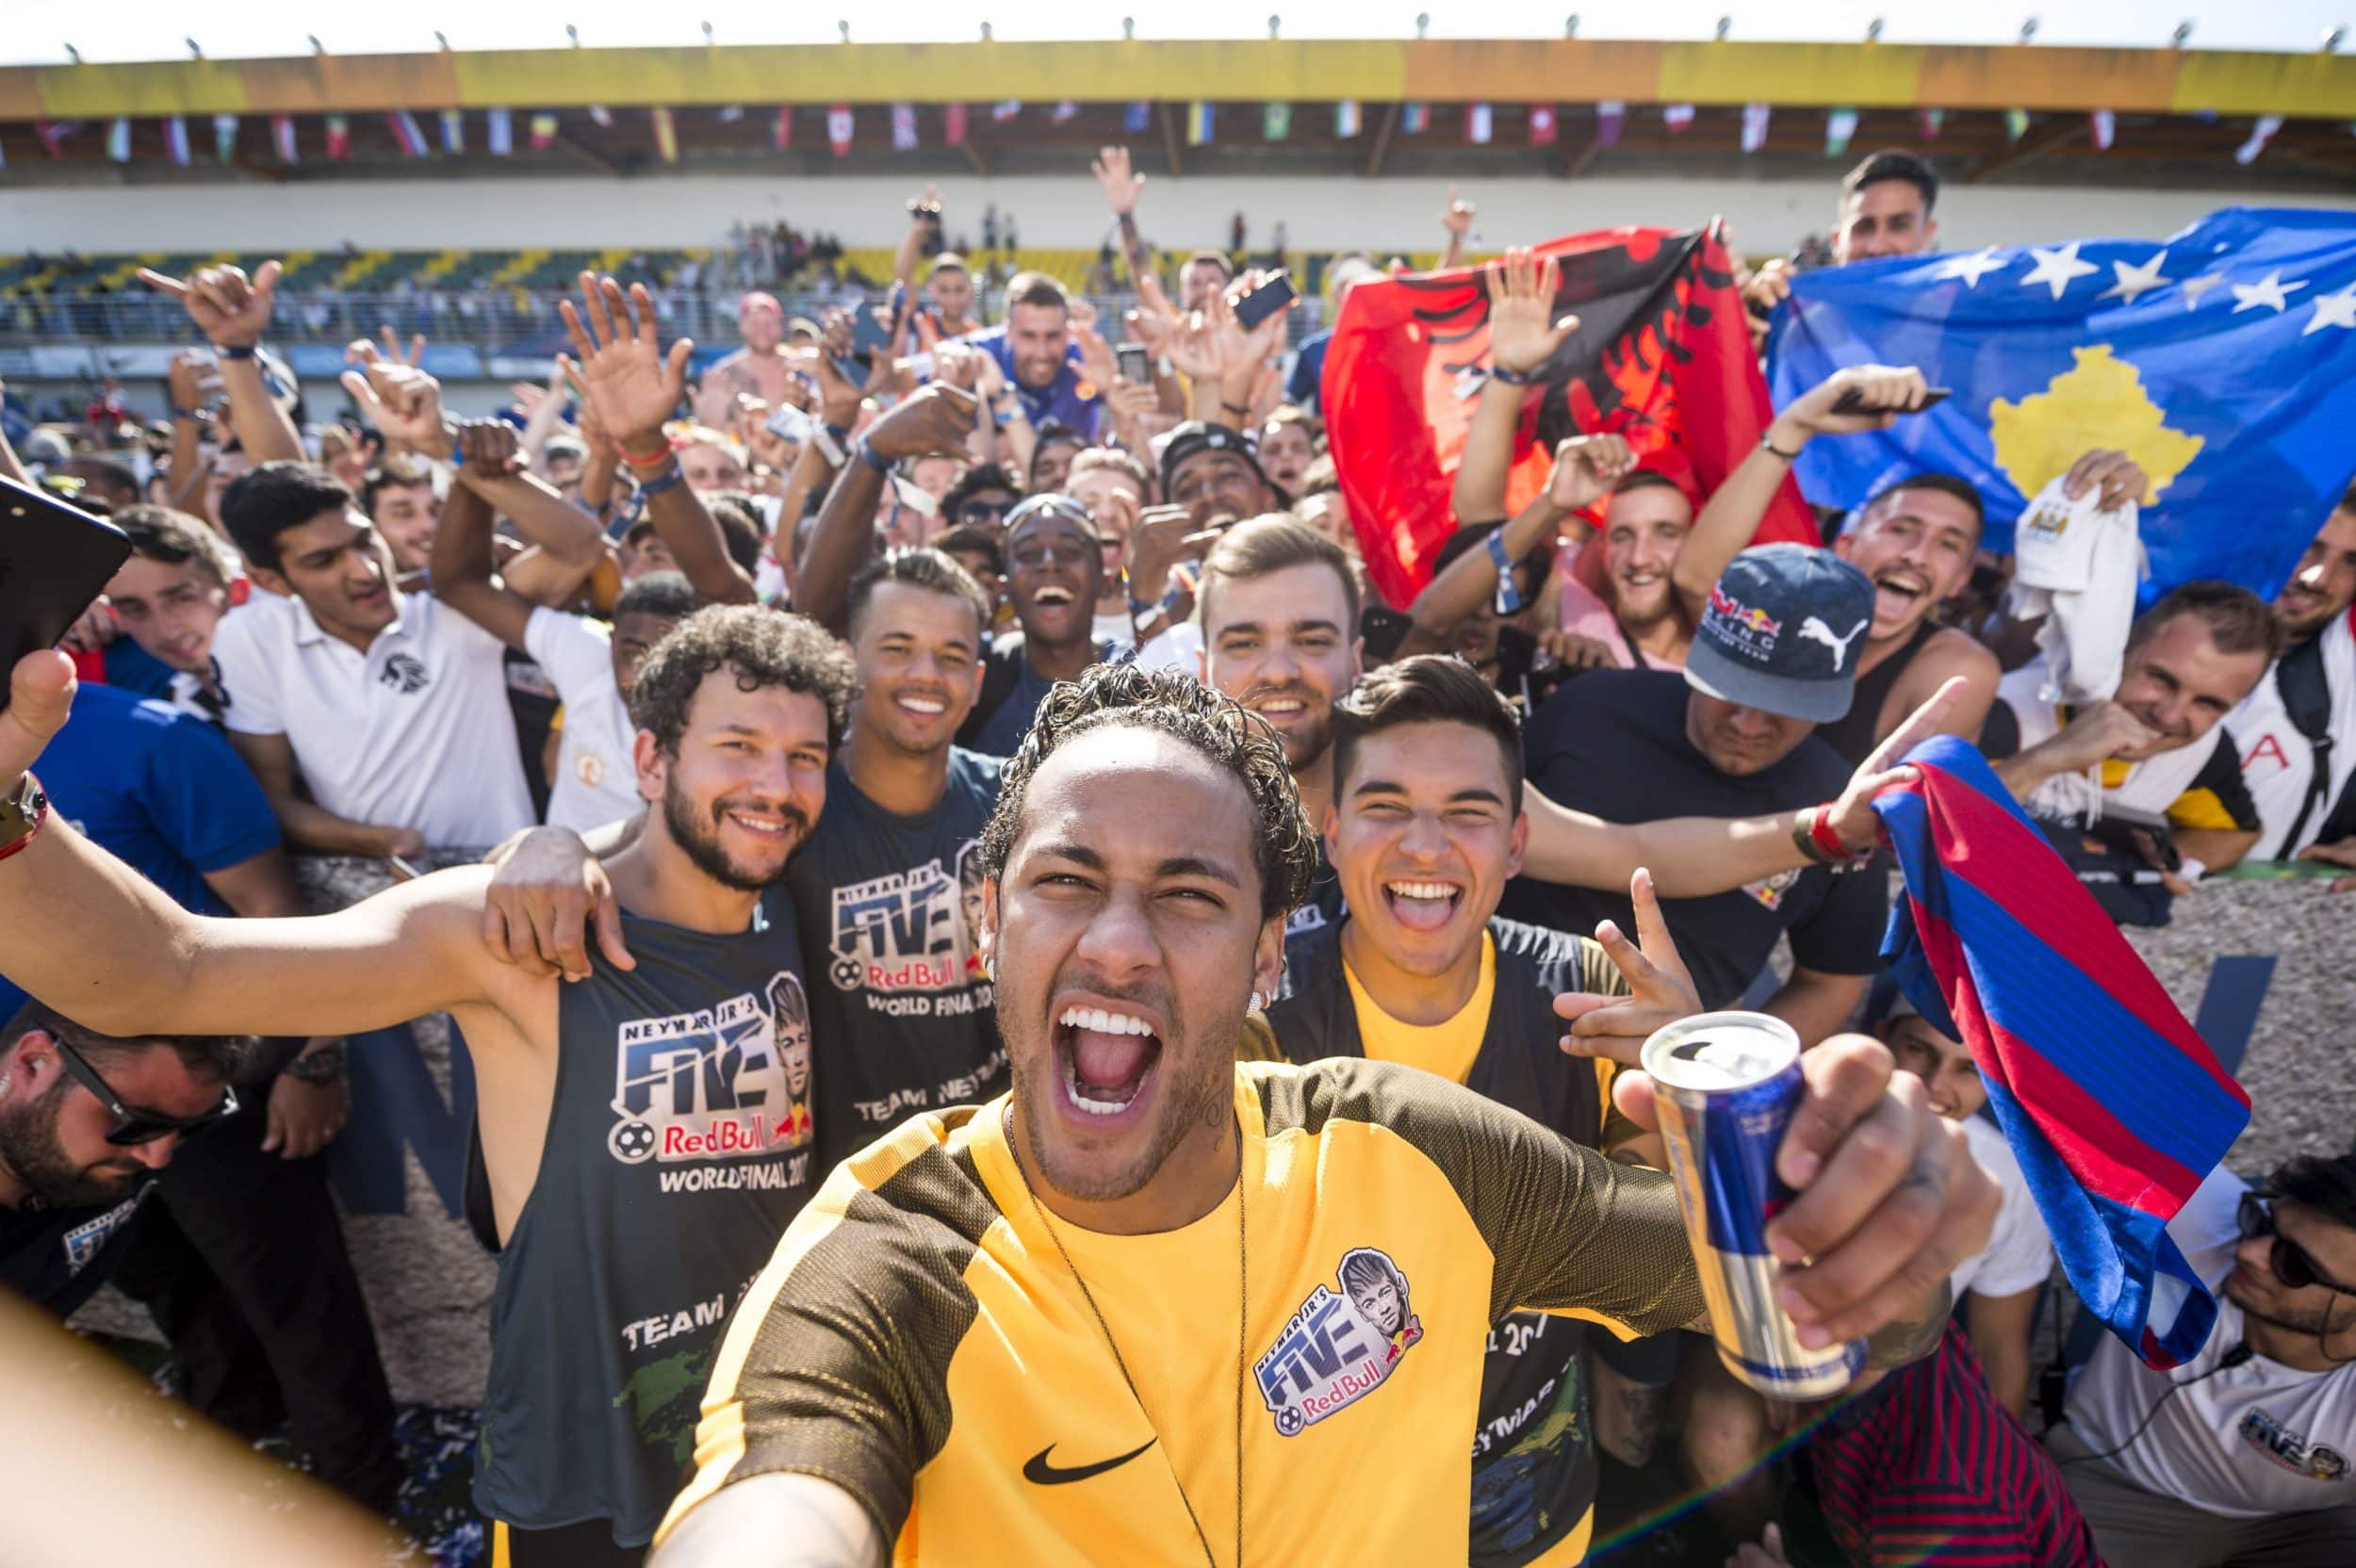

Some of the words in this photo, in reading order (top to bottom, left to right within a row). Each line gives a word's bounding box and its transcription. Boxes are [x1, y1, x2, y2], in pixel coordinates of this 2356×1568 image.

[868, 963, 910, 988] Red
[914, 956, 954, 986] Bull
[625, 1015, 711, 1041] NEYMAR
[719, 996, 754, 1023] JR'S
[866, 993, 931, 1017] WORLD
[623, 1016, 770, 1118] FIVE
[853, 1087, 928, 1121] TEAM
[664, 1119, 718, 1155] Red
[722, 1114, 765, 1151] Bull
[660, 1166, 742, 1194] WORLD
[739, 1160, 789, 1191] FINAL
[621, 1293, 725, 1352] TEAM
[1256, 1316, 1301, 1373] NEYMAR
[1301, 1288, 1328, 1320] JR'S
[1261, 1297, 1369, 1406] FIVE
[1301, 1381, 1346, 1418] Red
[1339, 1359, 1381, 1397] Bull
